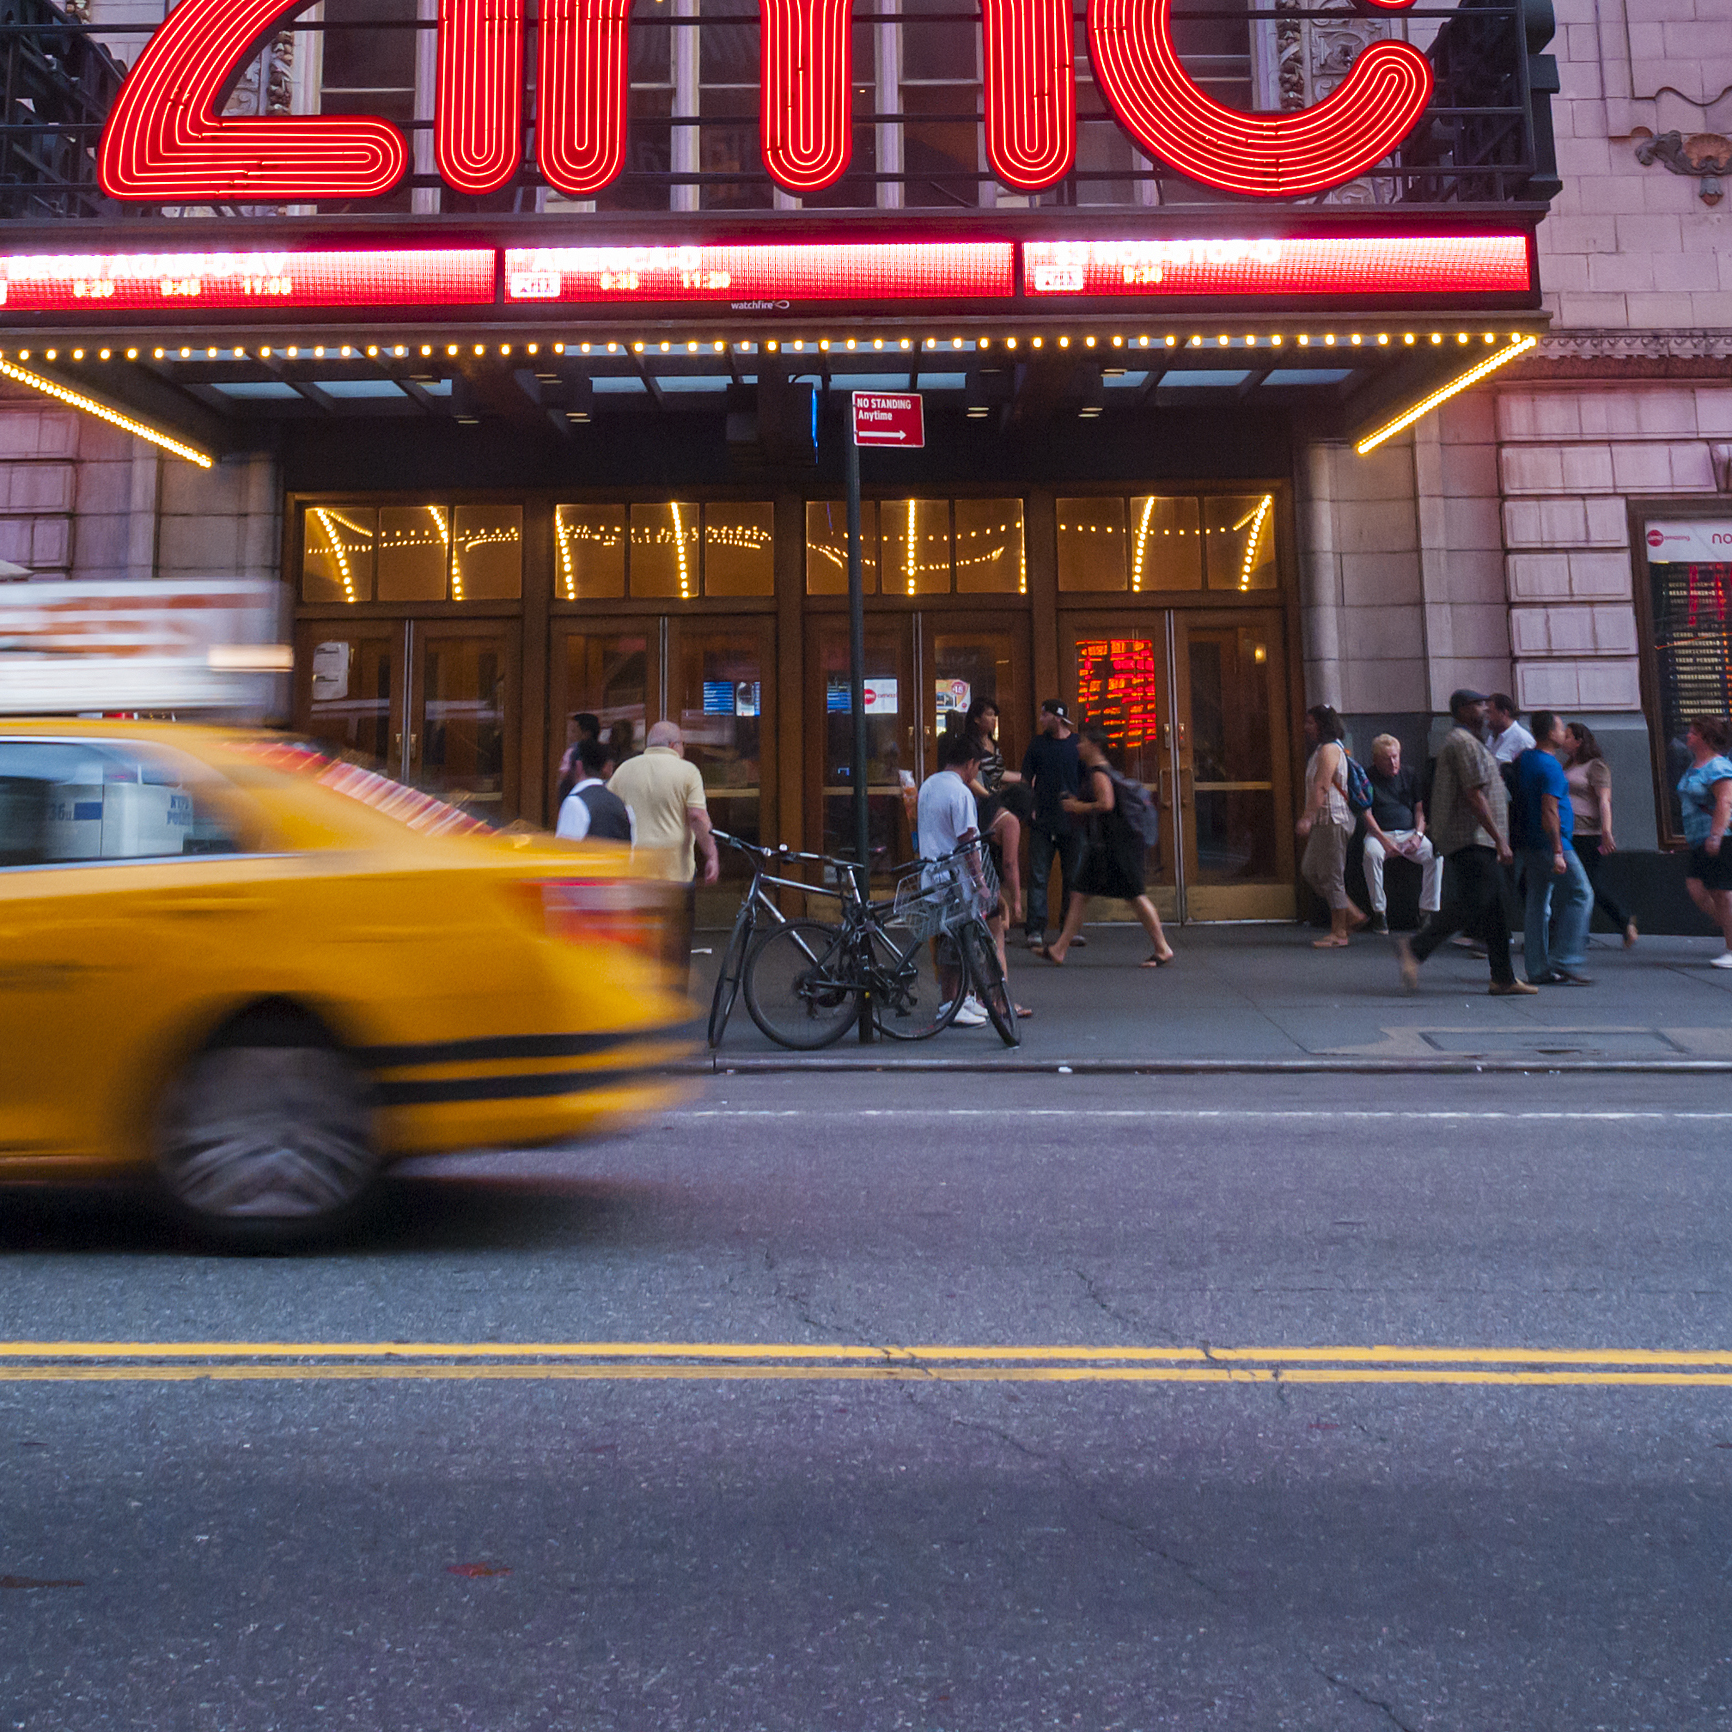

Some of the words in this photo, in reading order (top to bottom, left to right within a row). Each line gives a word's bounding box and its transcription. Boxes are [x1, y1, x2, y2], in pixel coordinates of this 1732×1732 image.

[731, 300, 774, 310] watchfire
[856, 397, 870, 409] NO
[870, 398, 912, 410] STANDING
[858, 409, 893, 422] Anytime
